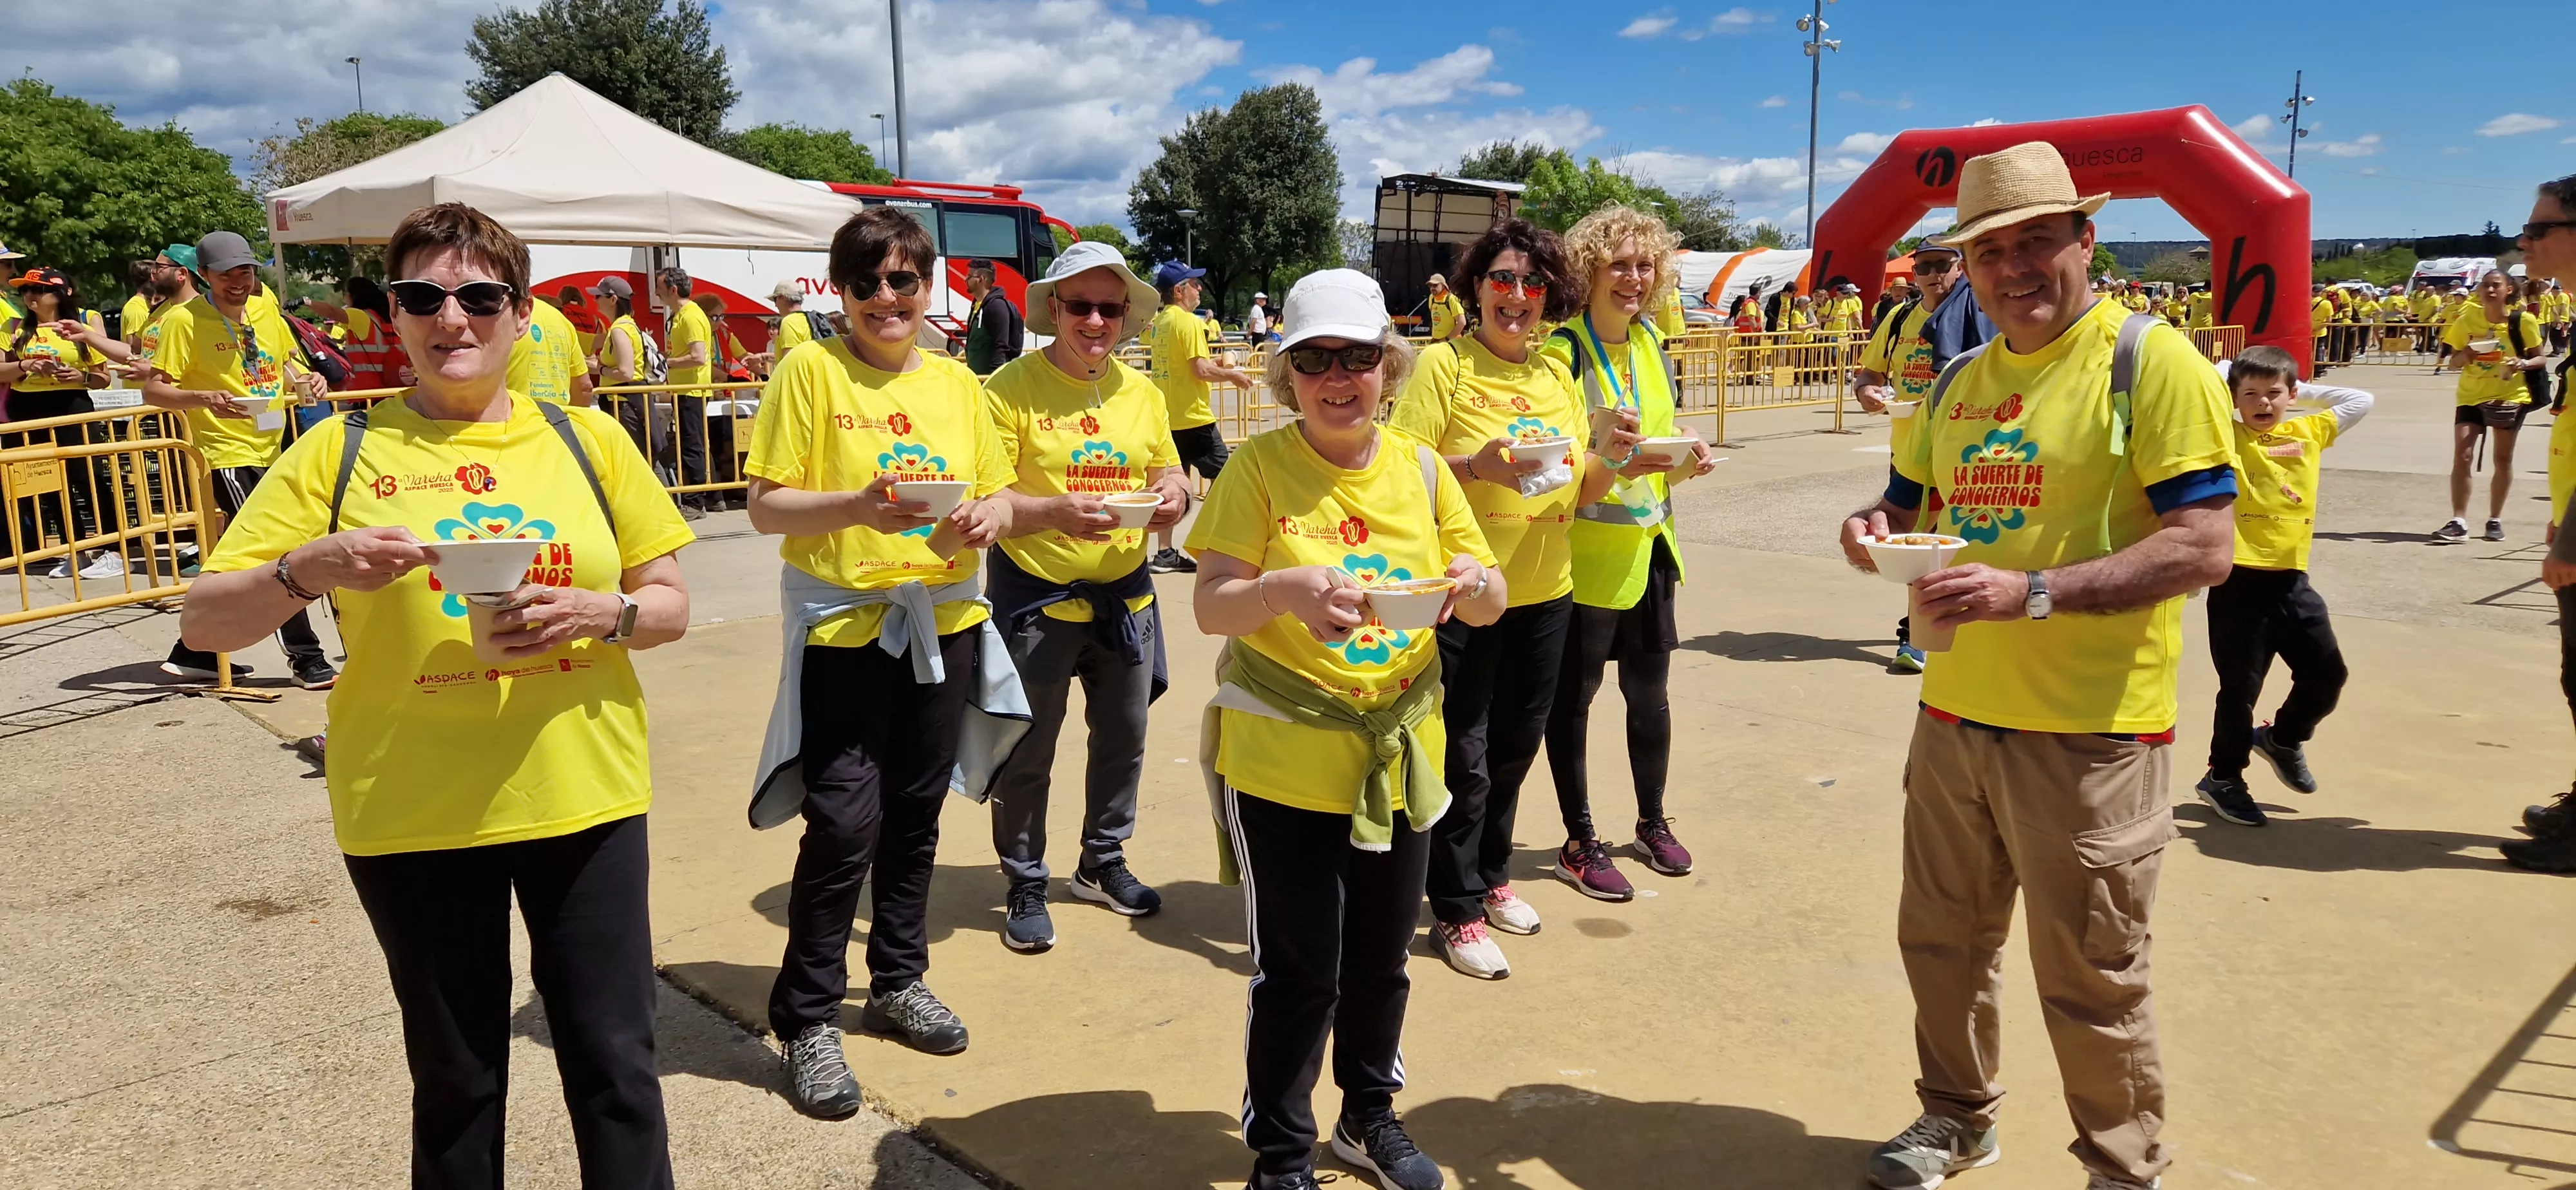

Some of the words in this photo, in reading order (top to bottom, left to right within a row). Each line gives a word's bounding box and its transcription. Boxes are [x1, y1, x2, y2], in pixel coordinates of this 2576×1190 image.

[857, 414, 886, 425] Marcha
[403, 472, 453, 486] Marcha
[1066, 465, 1079, 478] LA
[1081, 465, 1118, 479] SUERTE
[1118, 467, 1131, 480] DE
[1954, 466, 1968, 486] LA
[1971, 464, 2022, 486] SUERTE
[2023, 464, 2044, 486] DE
[1066, 478, 1133, 492] CONOCERNOS
[1947, 486, 2041, 507] CONOCERNOS
[1301, 521, 1338, 535] Marcha
[549, 543, 573, 565] DE
[427, 671, 476, 684] ASPACE
